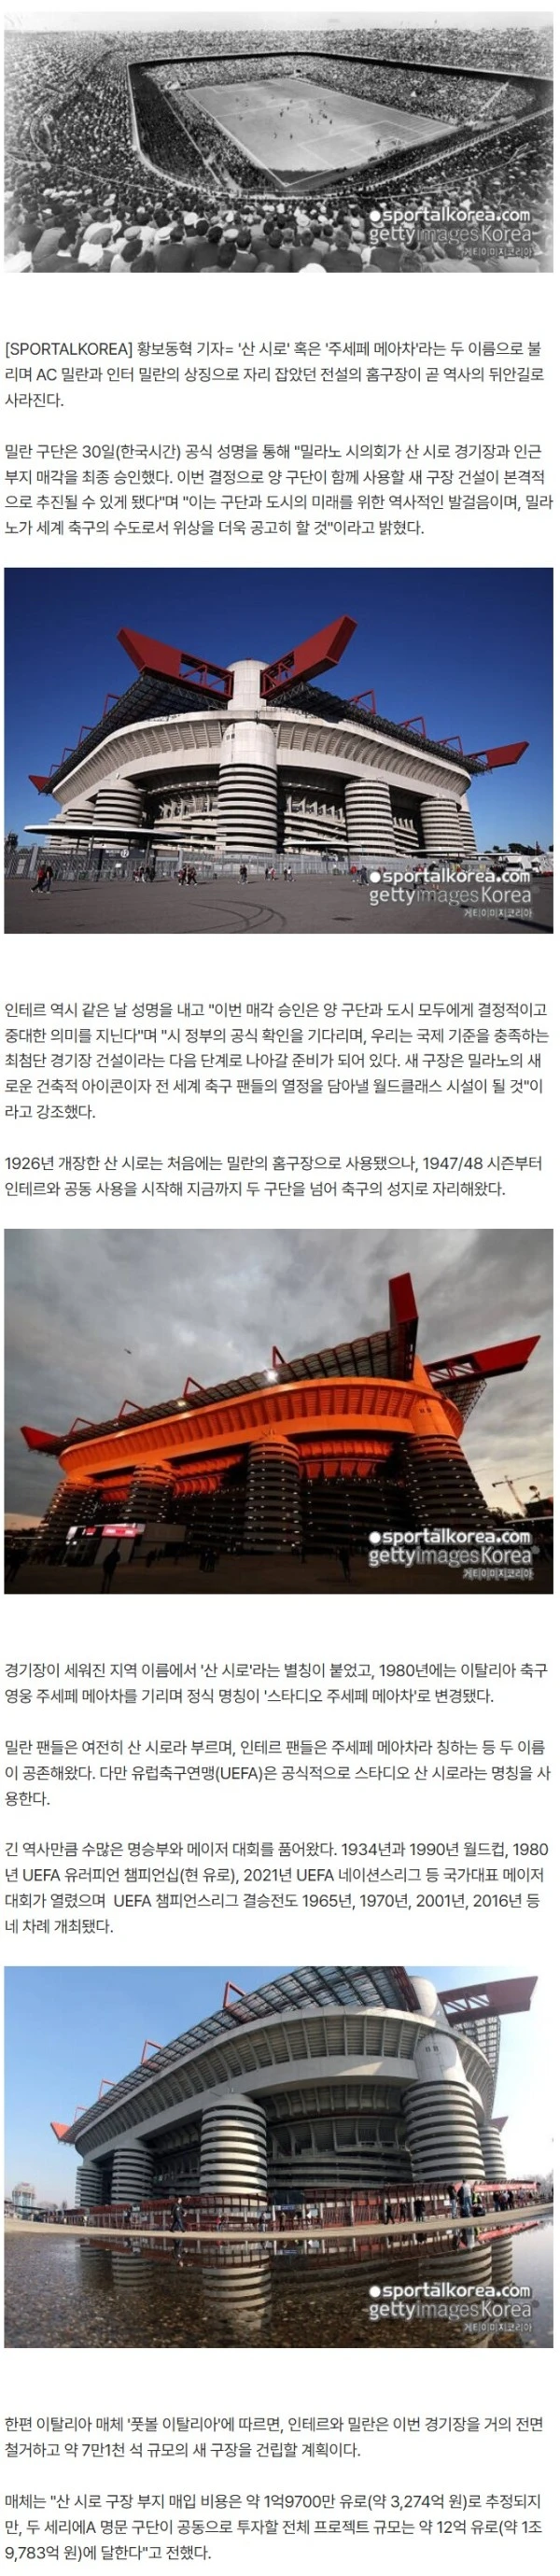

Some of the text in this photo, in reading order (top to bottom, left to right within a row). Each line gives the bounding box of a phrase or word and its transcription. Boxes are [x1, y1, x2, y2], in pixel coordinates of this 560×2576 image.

[7, 342, 540, 359] [SPORTALKOREA] 황보동혁 기자= '산 시로' 혹은 '주세페 메아차'라는 두 이름으로 불
[6, 393, 63, 407] 사라진다.
[5, 470, 544, 485] 부지 매각을 최종 승인했다. 이번 결정으로 양 구단이 함께 사용할 새 구장 건설이 본격적
[6, 1028, 549, 1045] 중대한 의미를 지닌다"며 "시 정부의 공식 확인을 기다리며, 우리는 국제 기준을 충족하는
[6, 1053, 540, 1068] 최첨단 경기장 건설이라는 다음 단계로 나아갈 준비가 되어 있다. 새 구장은 밀라노의 새
[5, 1078, 542, 1093] 로운 건축적 아이콘이자 전 세계 축구 팬들의 열정을 담아낼 월드클래스 시설이 될 것"이
[6, 1156, 541, 1173] 1926년 개장한 산 시로는 처음에는 밀란의 홈구장으로 사용됐으나, 1947/48 시즌부터
[6, 1663, 548, 1680] 경기장이 세워진 지역 이름에서 '산 시로'라는 별칭이 붙었고, 1980년에는 이탈리아 축구
[6, 1740, 545, 1756] 밀란 팬들은 여전히 산 시로라 부르며, 인테르 팬들은 주세페 메아차라 칭하는 등 두 이름
[6, 1792, 49, 1807] 용한다.
[6, 1867, 543, 1884] 년 UEFA 유러피언 챔피언십(현 유로), 2021년 UEFA 네이션스리그 등 국가대표 메이저
[6, 1919, 113, 1934] 네 차례 개최됐다.
[6, 2442, 360, 2457] 철거하고 약 7만1천 석 규모의 새 구장을 건립할 계획이다.
[6, 2520, 542, 2537] 만, 두 세리에A 명문 구단이 공동으로 투자할 전체 프로젝트 규모는 약 12억 유로(약 1조
